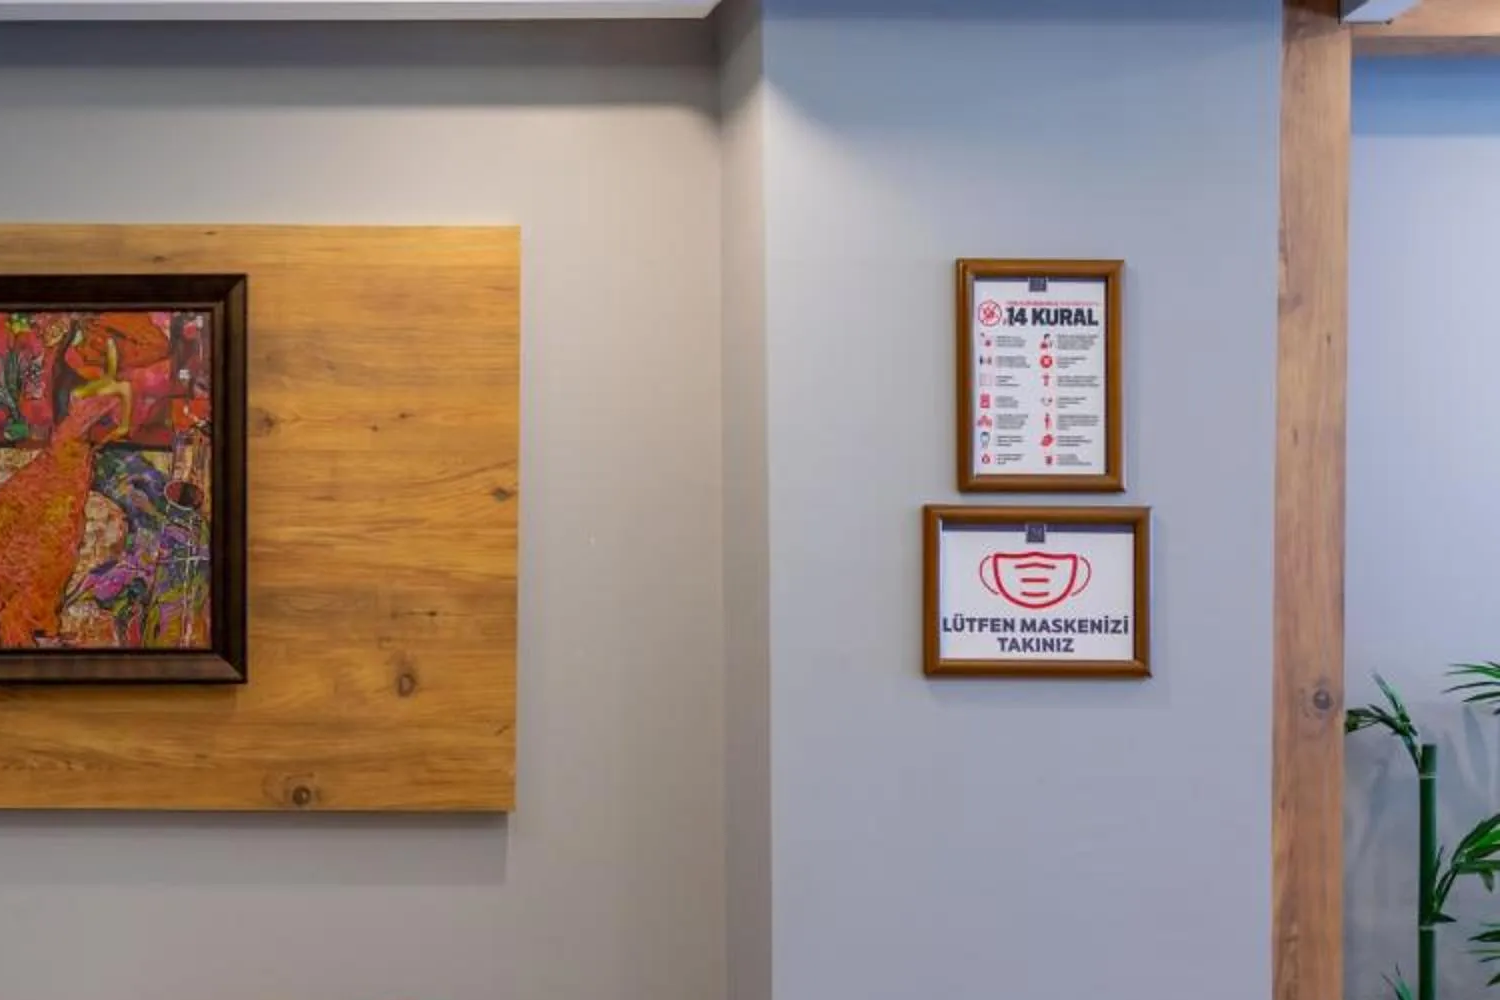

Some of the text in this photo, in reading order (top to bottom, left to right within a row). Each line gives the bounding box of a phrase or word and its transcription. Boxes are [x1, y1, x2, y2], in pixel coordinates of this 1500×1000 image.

[1006, 307, 1098, 326] 14 KURAL
[942, 614, 1129, 635] LÜTFEN MASKENİZİ
[997, 637, 1075, 653] TAKINIZ
